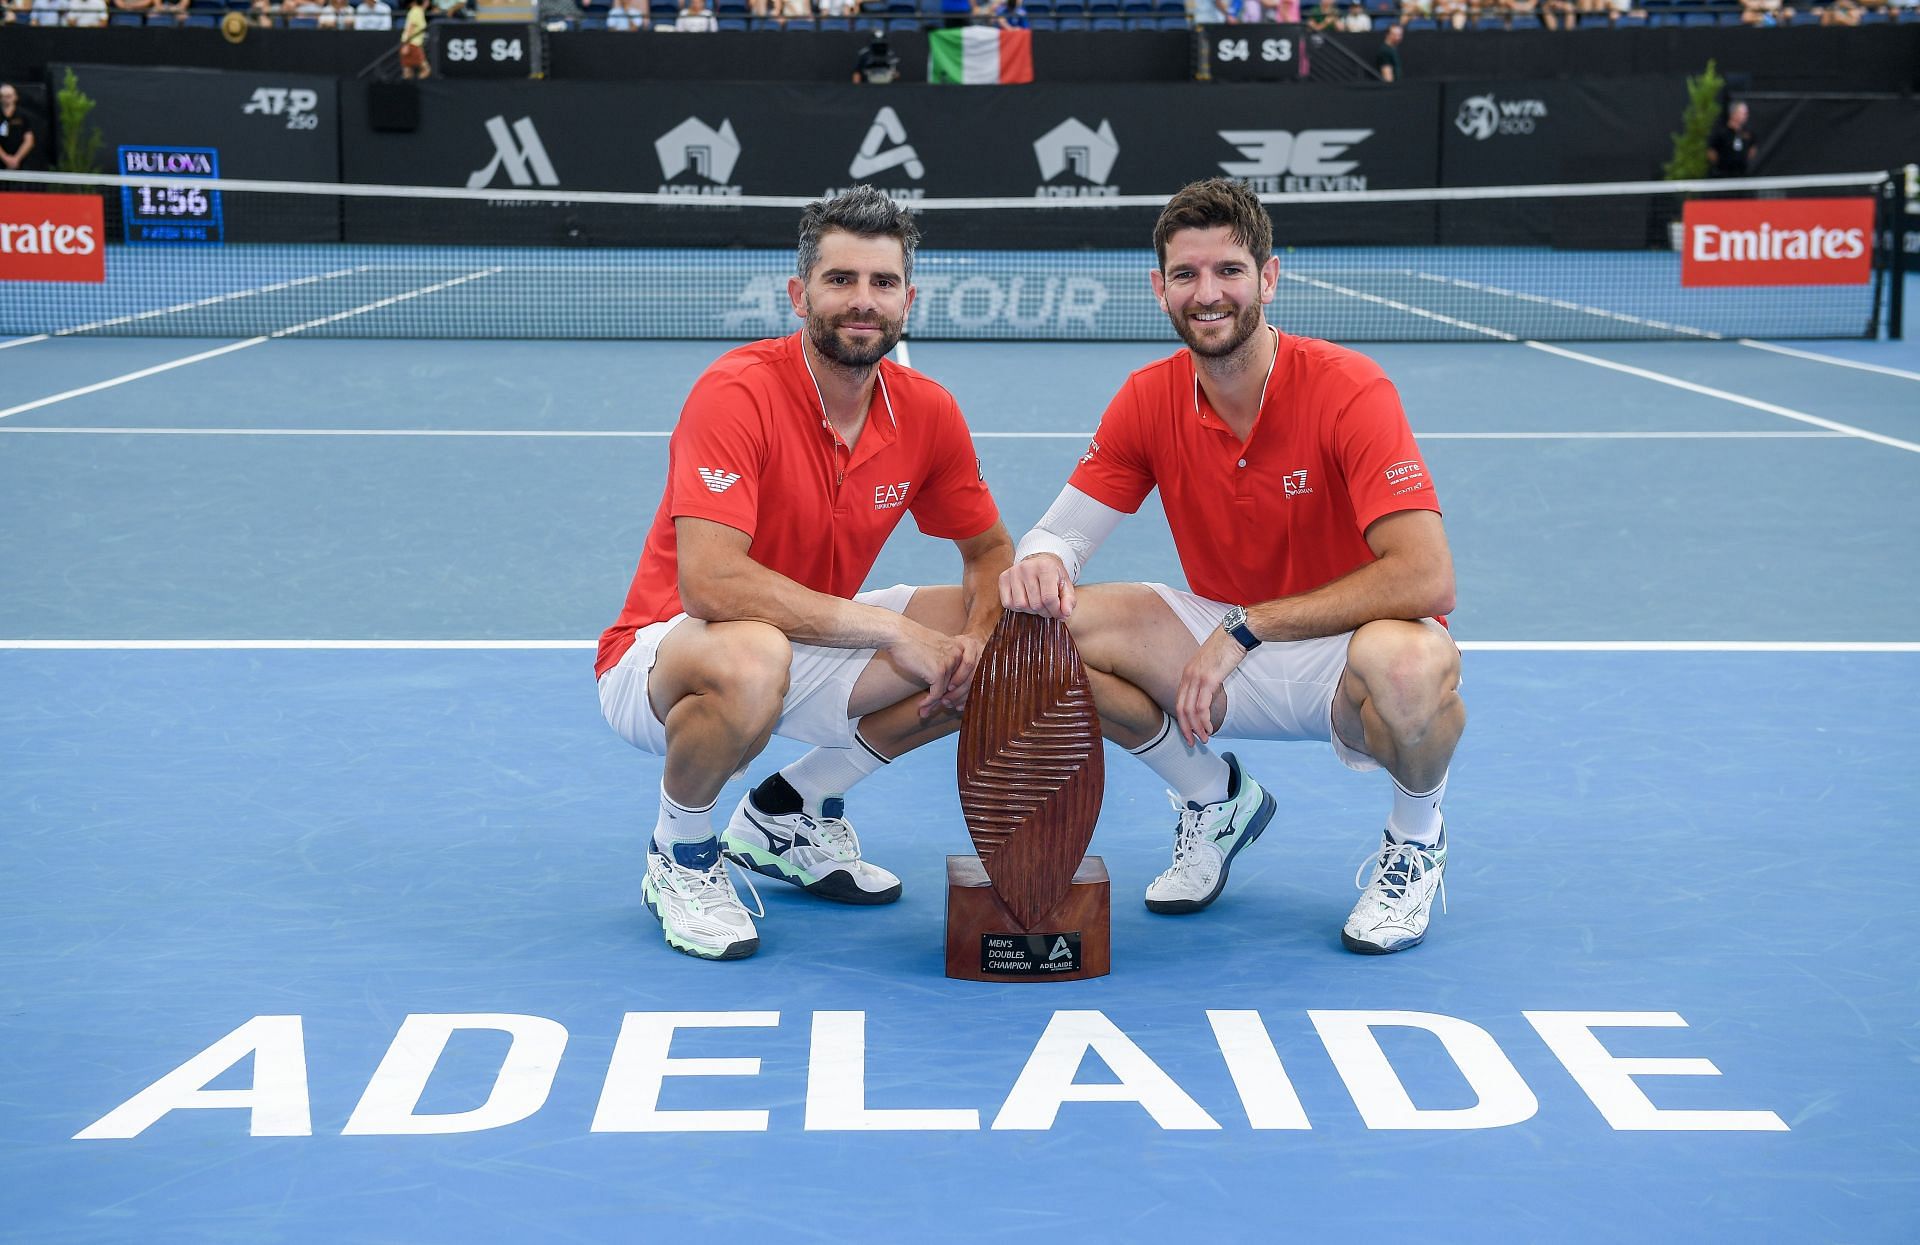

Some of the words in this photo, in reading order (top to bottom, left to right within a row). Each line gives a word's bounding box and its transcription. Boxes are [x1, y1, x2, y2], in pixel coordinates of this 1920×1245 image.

[447, 38, 478, 61] S5
[490, 38, 523, 61] S4
[1217, 39, 1249, 61] S4
[1261, 39, 1292, 61] S3
[241, 87, 318, 116] ATP
[1500, 99, 1548, 117] WTA
[286, 113, 319, 130] 250
[127, 152, 211, 173] BULOVA
[1284, 176, 1367, 192] ELEVEN
[138, 184, 208, 215] 1:56
[0, 219, 95, 255] rates
[1692, 221, 1864, 262] Emirates
[908, 275, 1110, 329] TOUR
[875, 481, 910, 503] EA7
[988, 939, 1013, 948] MEN'S
[988, 949, 1025, 959] DOUBLES
[988, 960, 1032, 970] CHAMPION
[1039, 961, 1073, 969] ADELAIDE
[71, 1010, 1790, 1139] ADELAIDE
